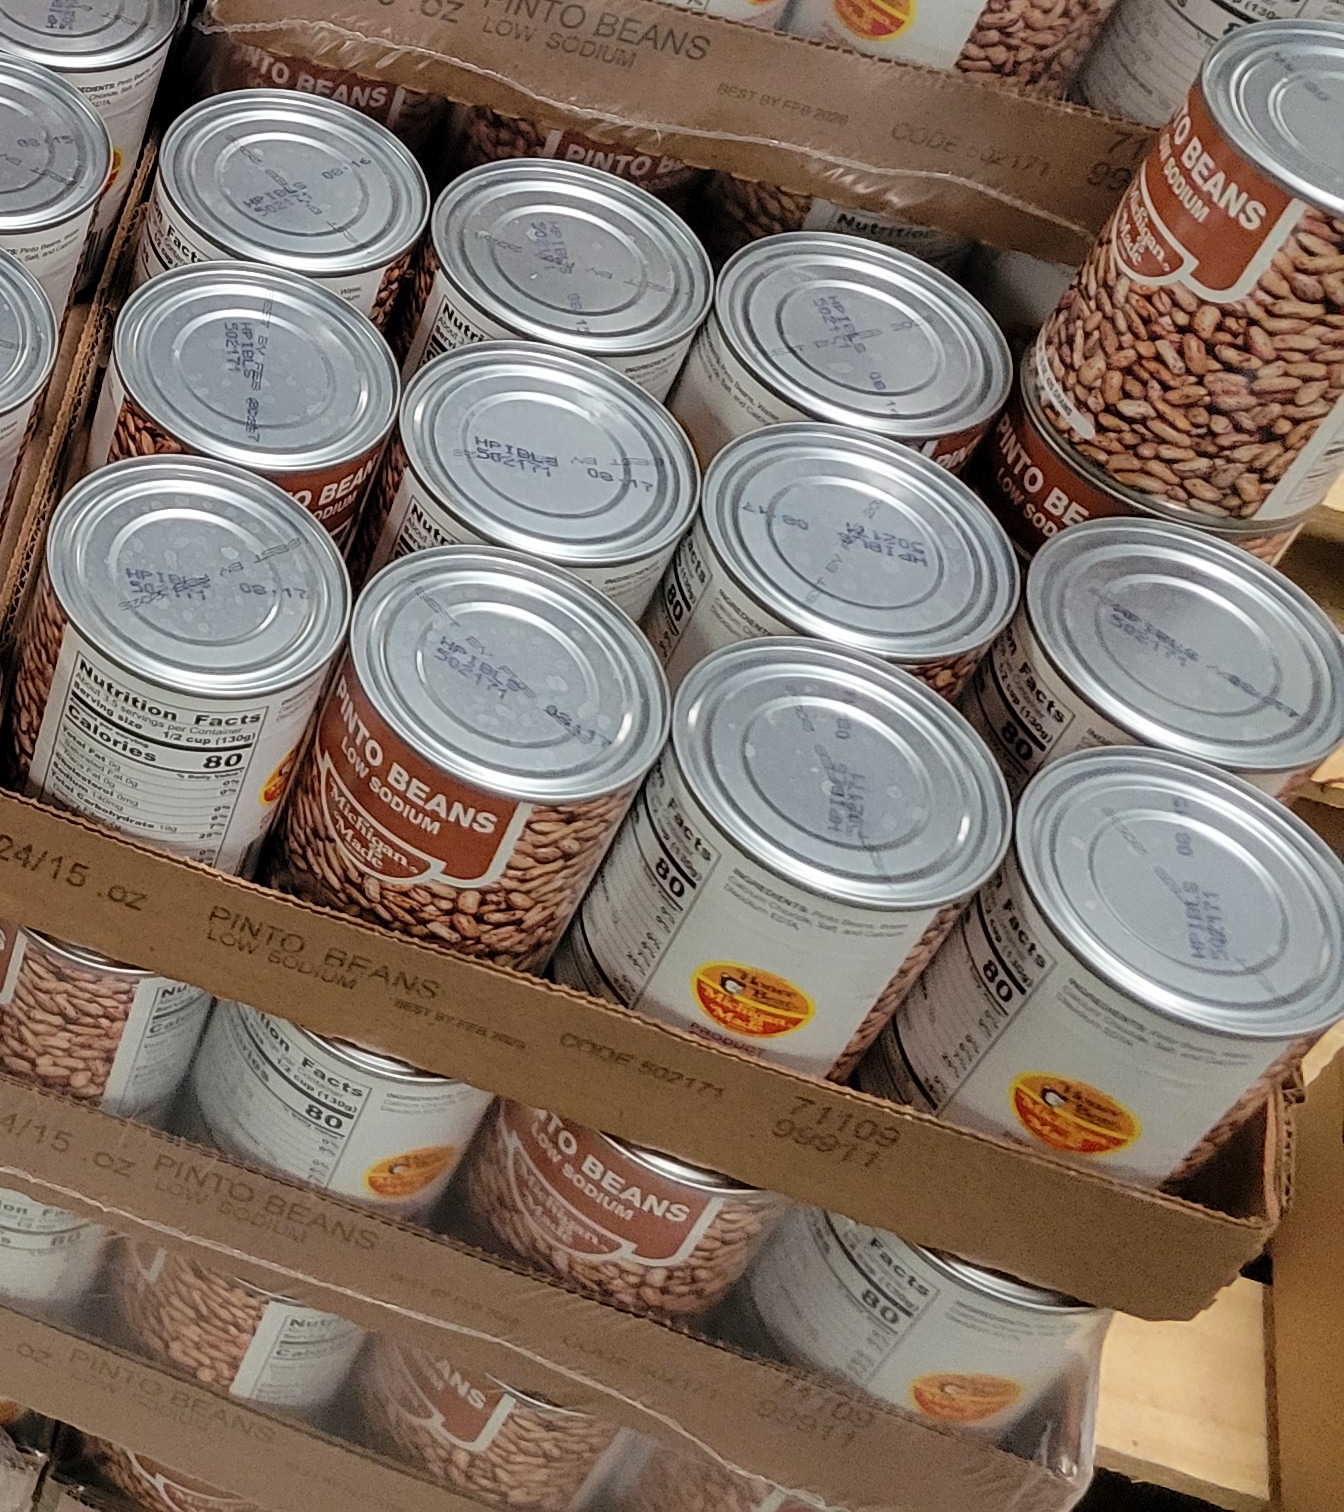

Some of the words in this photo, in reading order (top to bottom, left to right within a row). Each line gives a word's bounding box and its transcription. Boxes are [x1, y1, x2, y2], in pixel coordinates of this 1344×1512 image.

[481, 16, 537, 44] LOW
[543, 29, 638, 69] SODIUM
[593, 11, 712, 62] BEANS
[890, 121, 958, 154] CODE
[1182, 139, 1268, 231] BEANS
[73, 682, 115, 717] Serving
[163, 731, 183, 741] 1/2
[185, 736, 211, 745] cup
[215, 733, 256, 745] (130g)
[78, 659, 178, 722] Nutrition
[194, 713, 261, 726] Facts
[68, 705, 157, 762] Calories
[202, 752, 243, 769] 80
[335, 680, 383, 768] PINTO
[386, 761, 499, 834] BEANS
[340, 735, 370, 779] LOW
[369, 776, 442, 836] SODIUM
[329, 777, 411, 868] Michigan
[334, 811, 384, 868] Made
[205, 929, 260, 956] LOW
[208, 905, 307, 955] PINTO
[322, 948, 441, 1001] BEANS
[151, 1151, 255, 1205] PINTO
[264, 1192, 382, 1251] BEANS
[561, 1163, 635, 1224] SODIUM
[581, 1152, 692, 1226] BEANS
